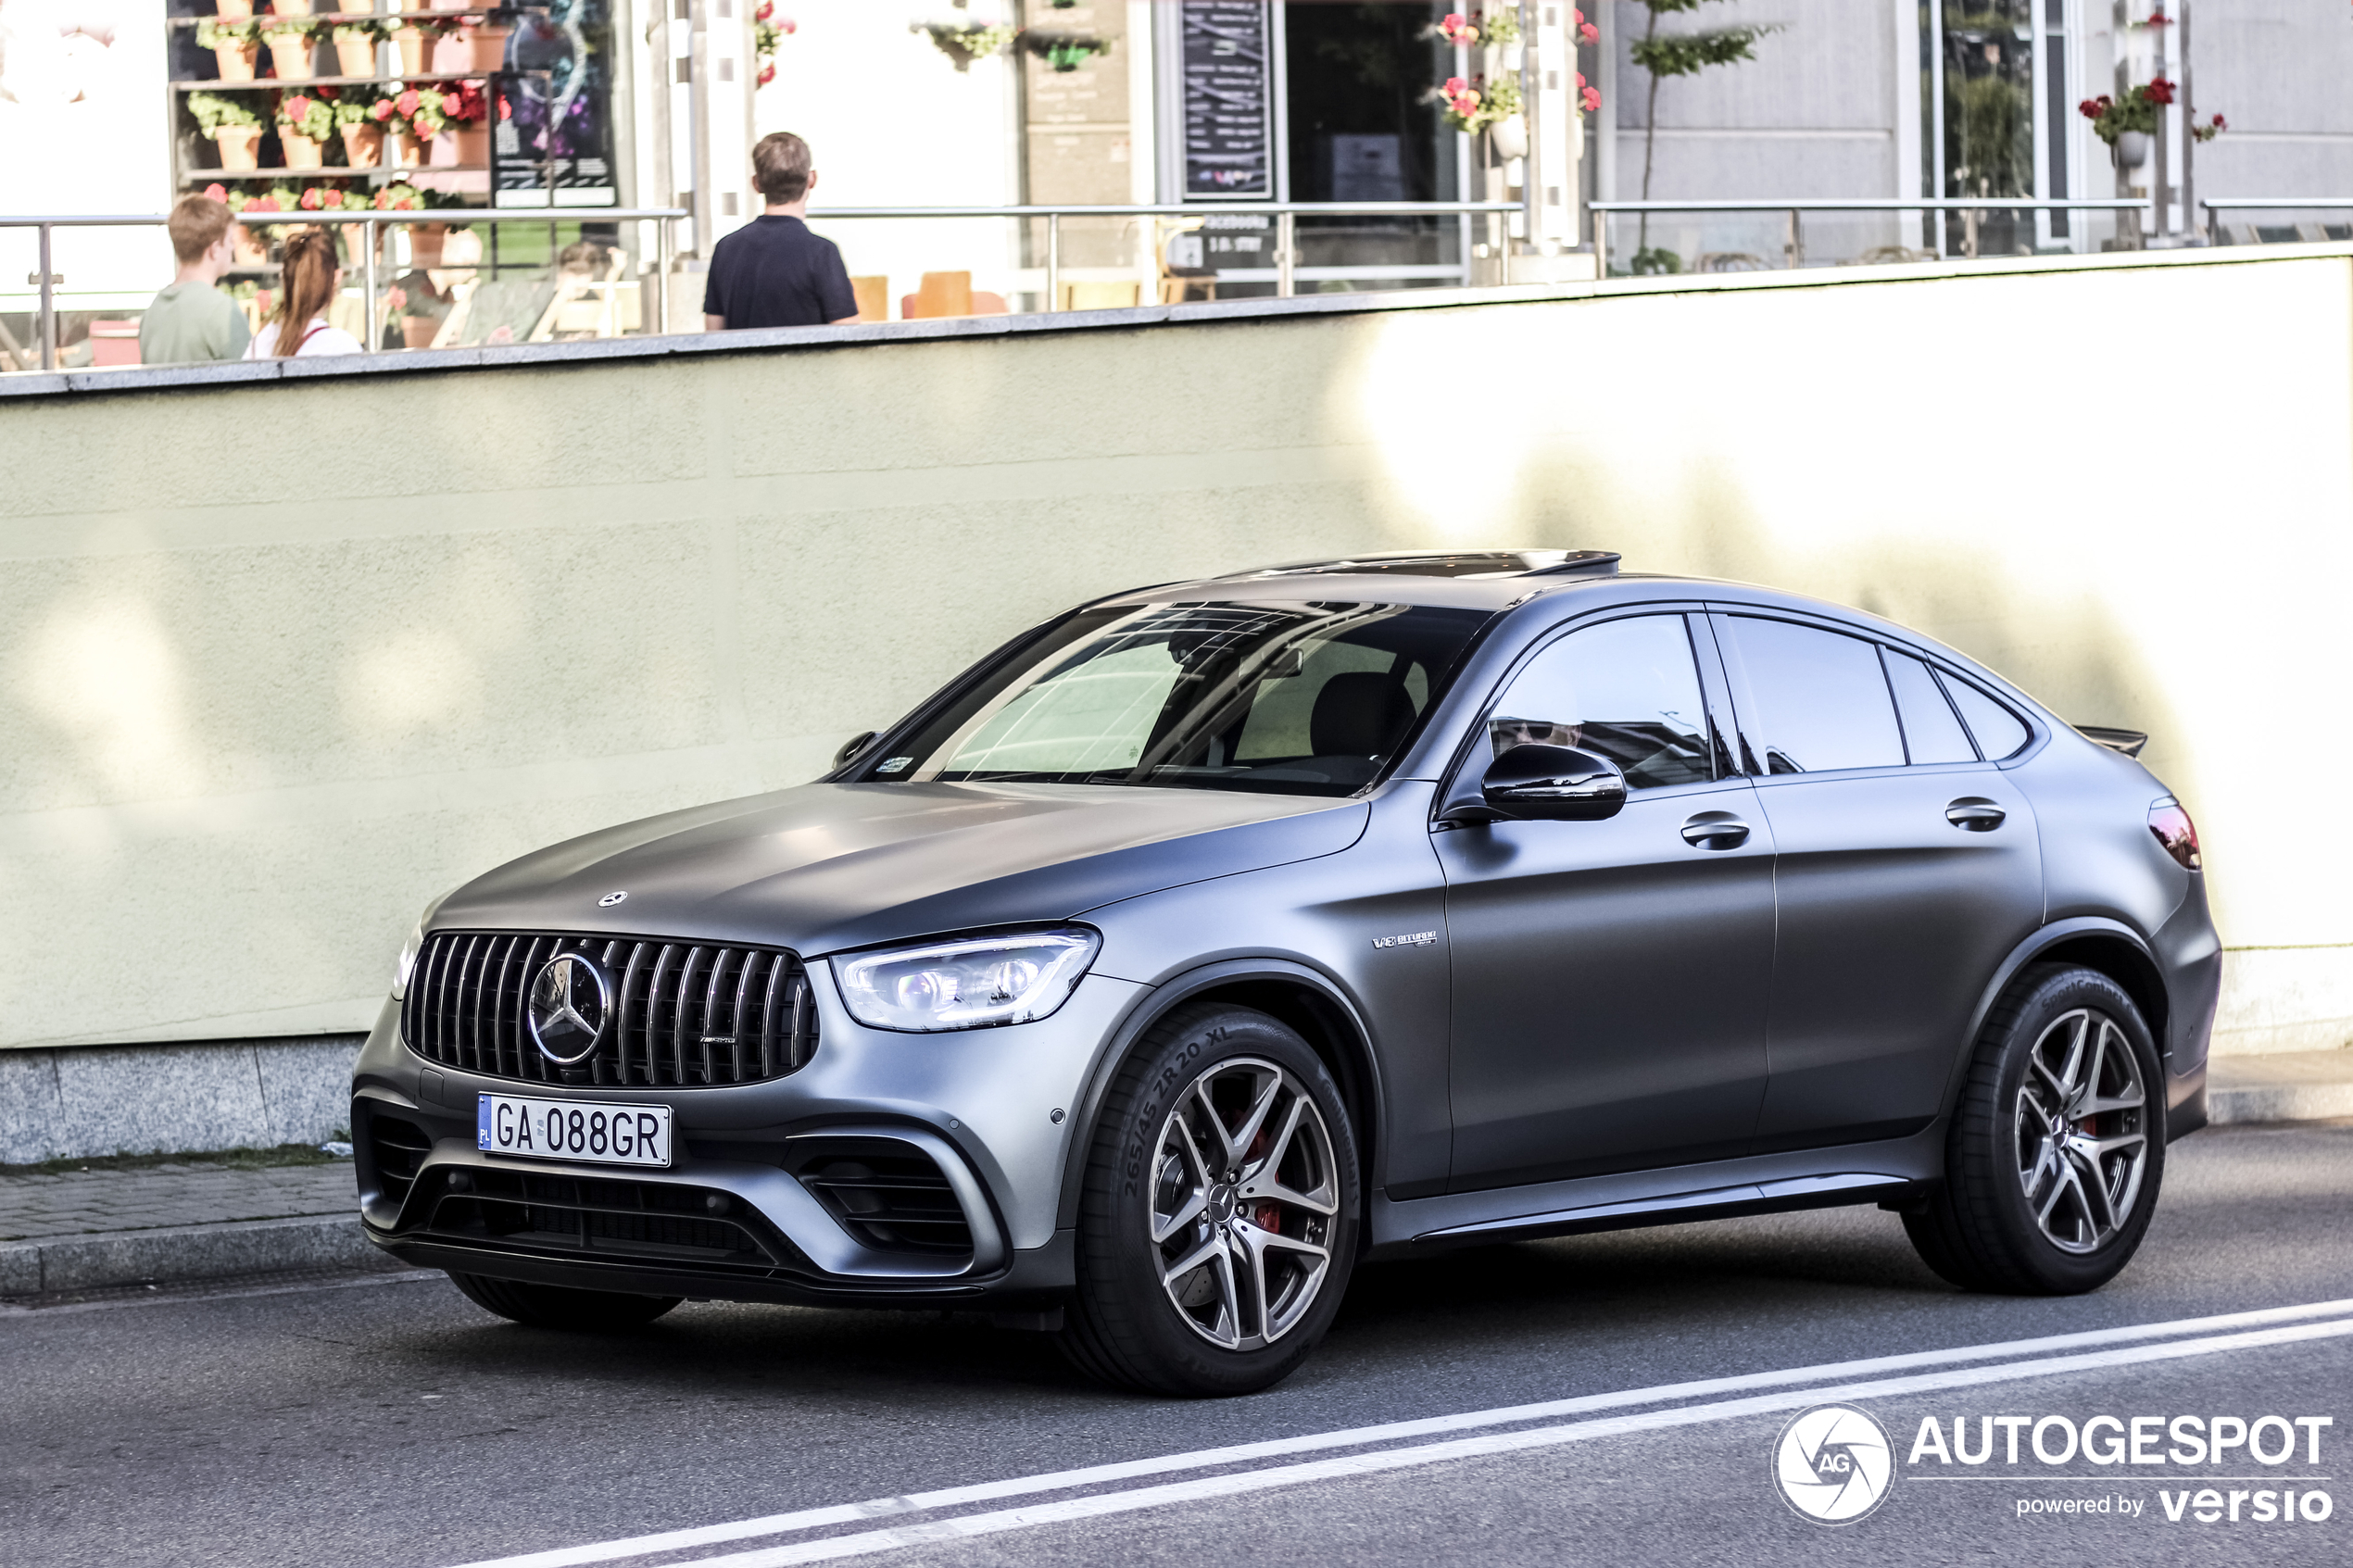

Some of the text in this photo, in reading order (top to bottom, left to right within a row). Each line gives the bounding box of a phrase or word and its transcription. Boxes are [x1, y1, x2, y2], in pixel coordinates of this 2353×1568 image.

[1372, 930, 1437, 948] V8 BITURBO
[497, 1102, 659, 1159] GA 088GR
[1124, 1026, 1232, 1198] 265/45 ZR 20 XL
[479, 1128, 490, 1141] PL
